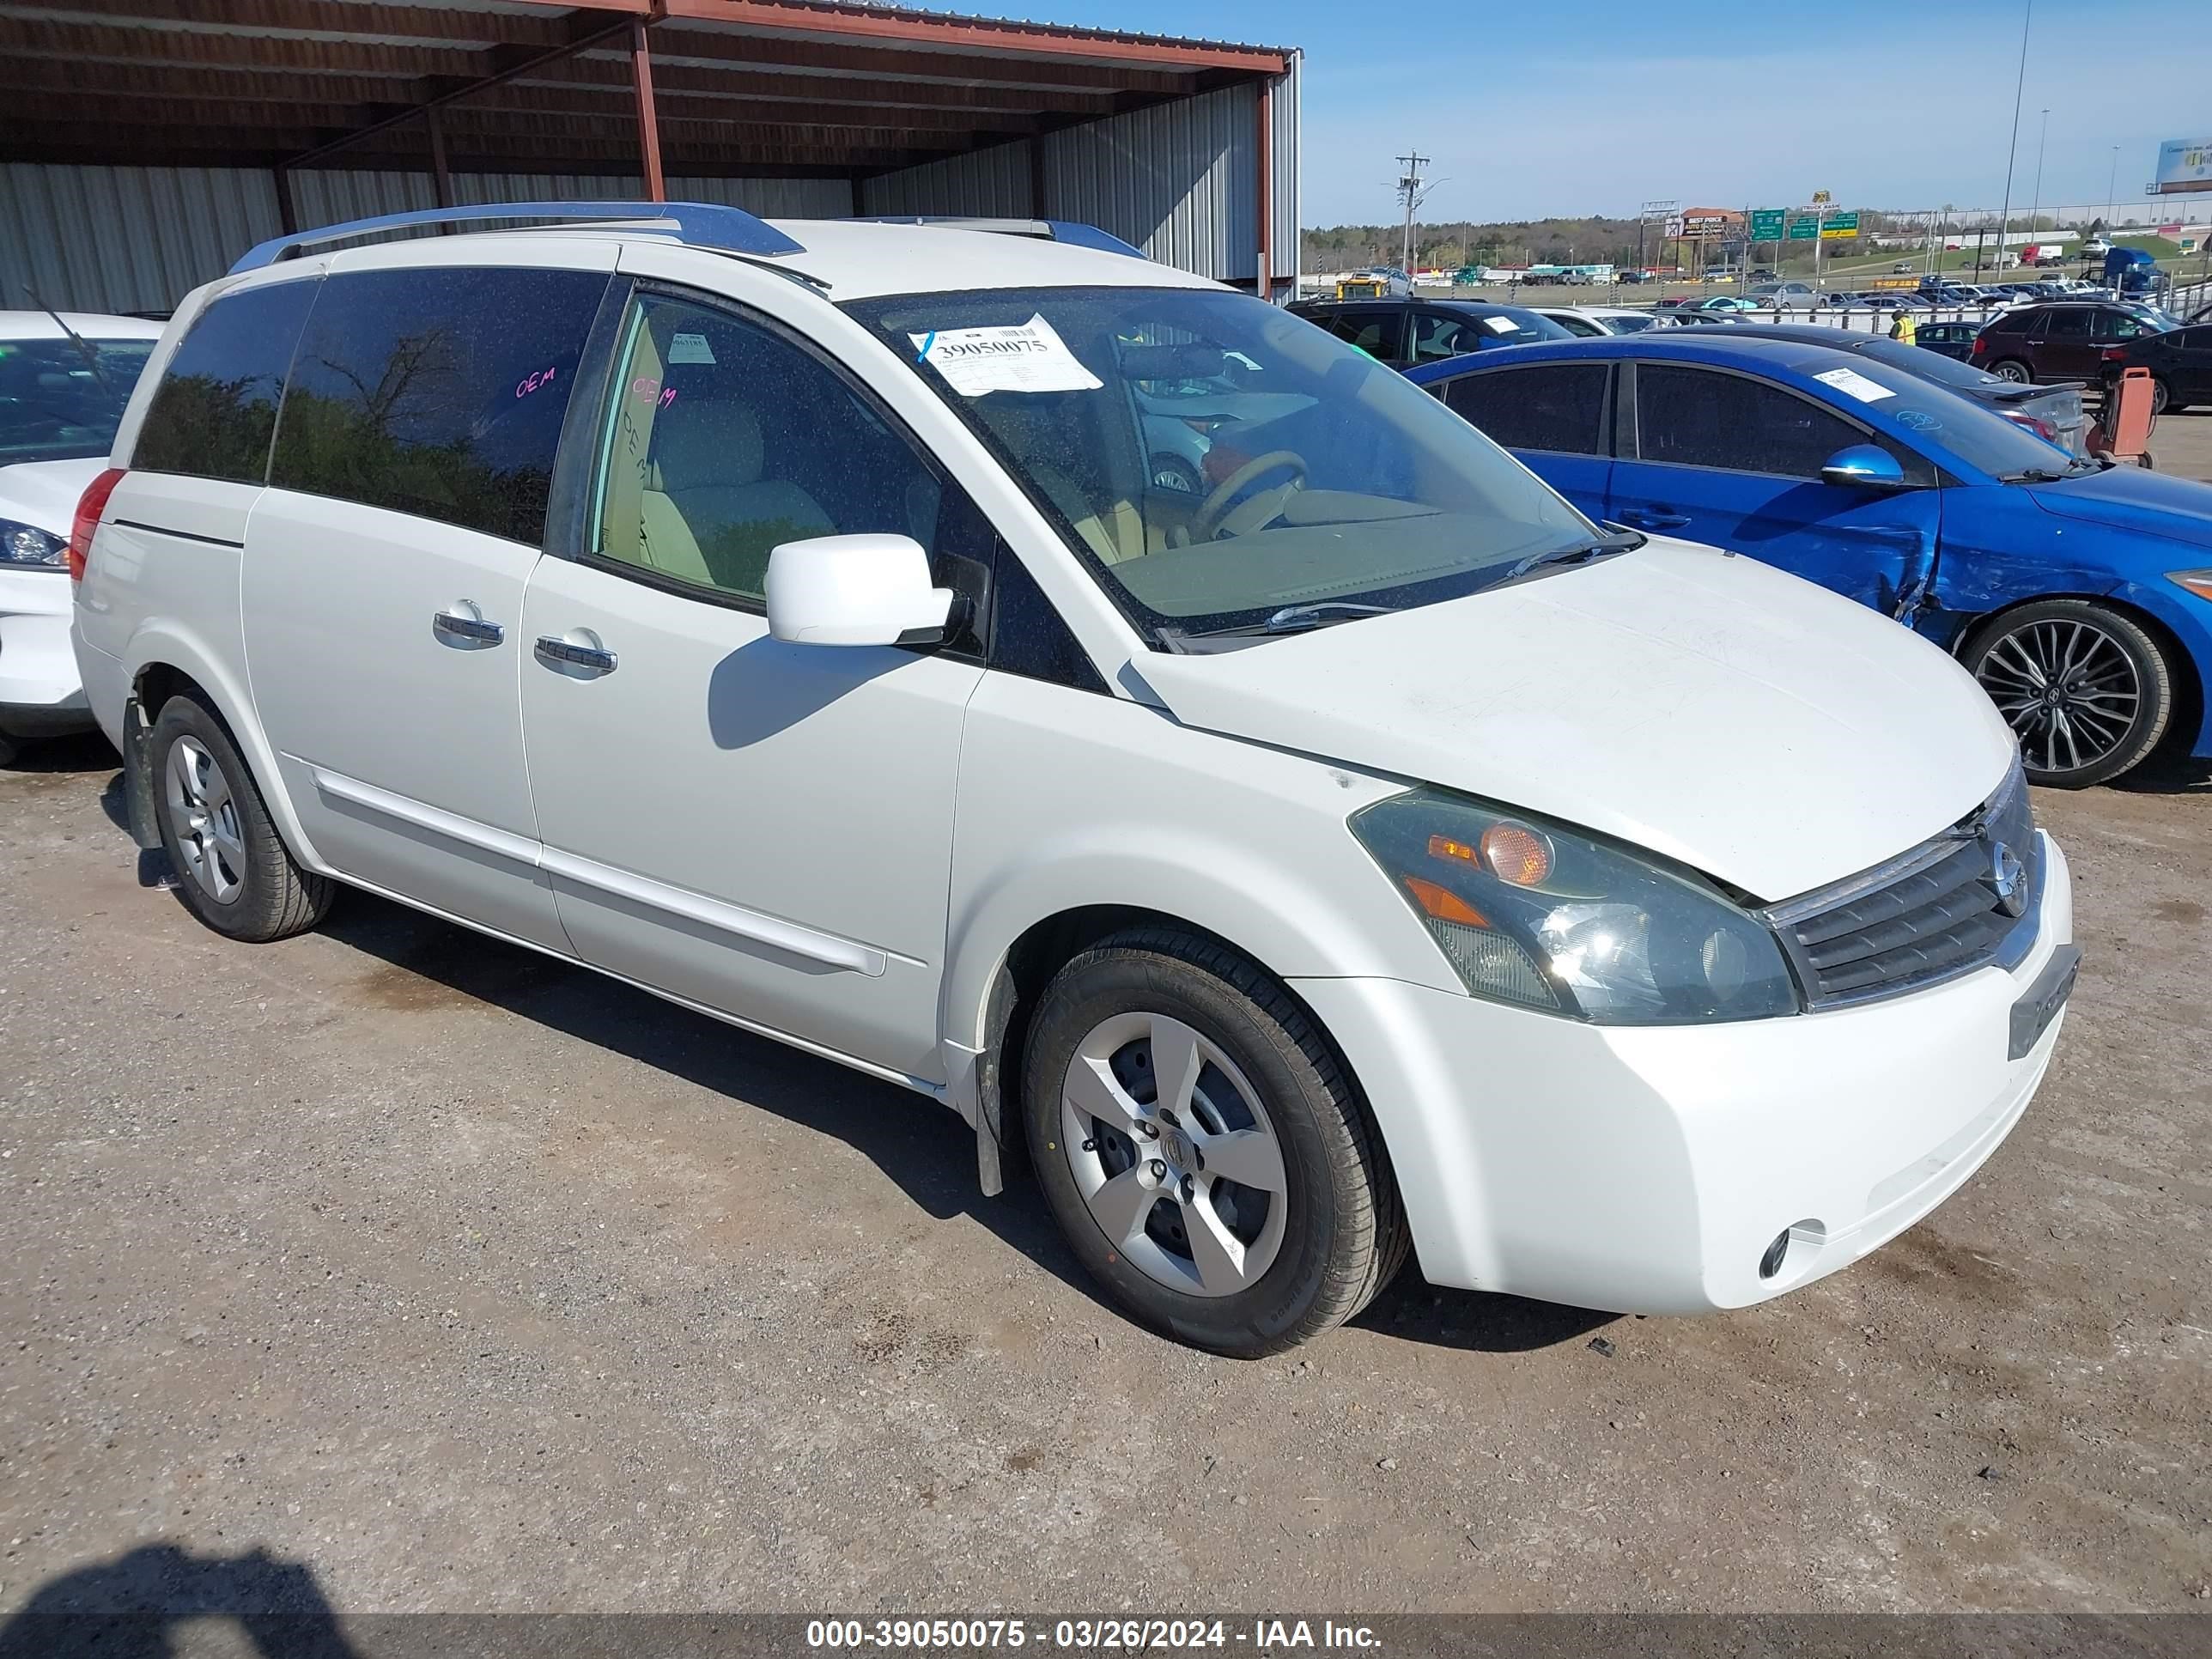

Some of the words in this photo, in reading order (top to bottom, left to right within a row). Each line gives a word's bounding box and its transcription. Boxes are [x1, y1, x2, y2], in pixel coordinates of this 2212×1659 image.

[937, 341, 1048, 359] 39050075
[516, 367, 555, 398] OEM
[633, 378, 677, 410] OEM
